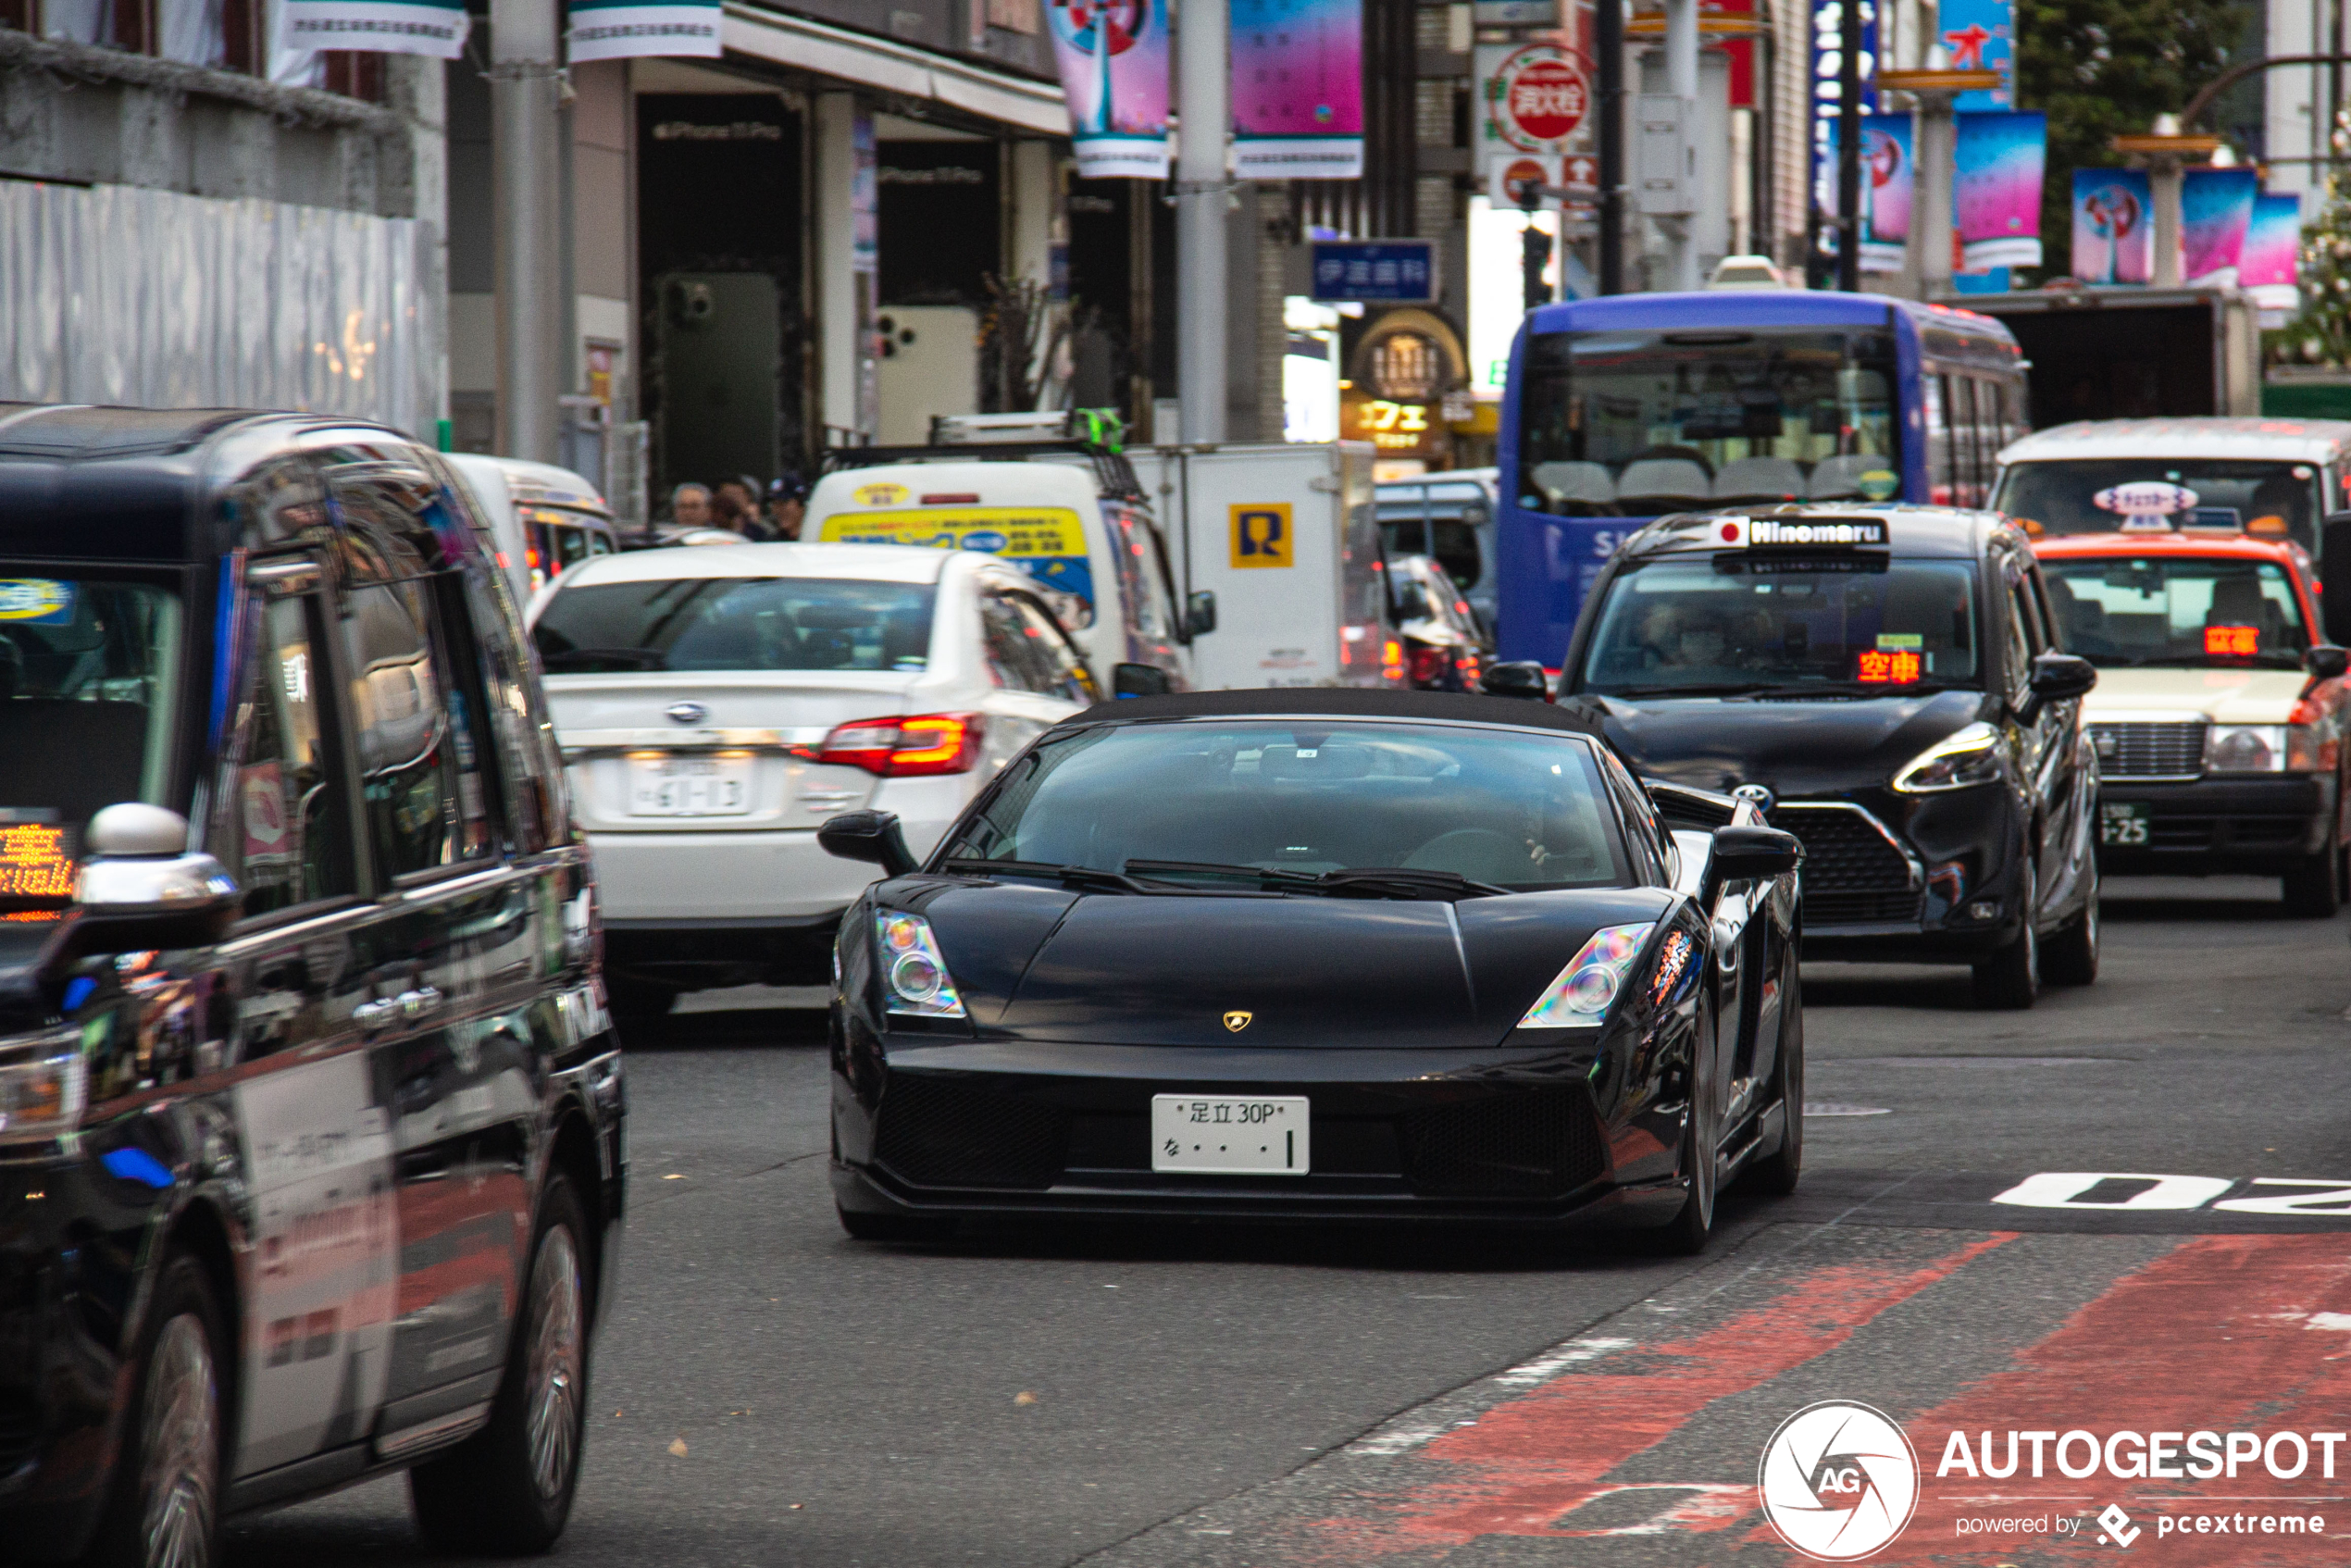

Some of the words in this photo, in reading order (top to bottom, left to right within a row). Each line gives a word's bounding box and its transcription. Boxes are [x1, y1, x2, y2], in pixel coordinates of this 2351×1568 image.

[1514, 83, 1582, 116] 消火栓
[1750, 520, 1881, 544] Hinomaru
[1858, 649, 1921, 684] 空車
[1189, 1102, 1232, 1124] 足立
[1237, 1102, 1275, 1124] 30P
